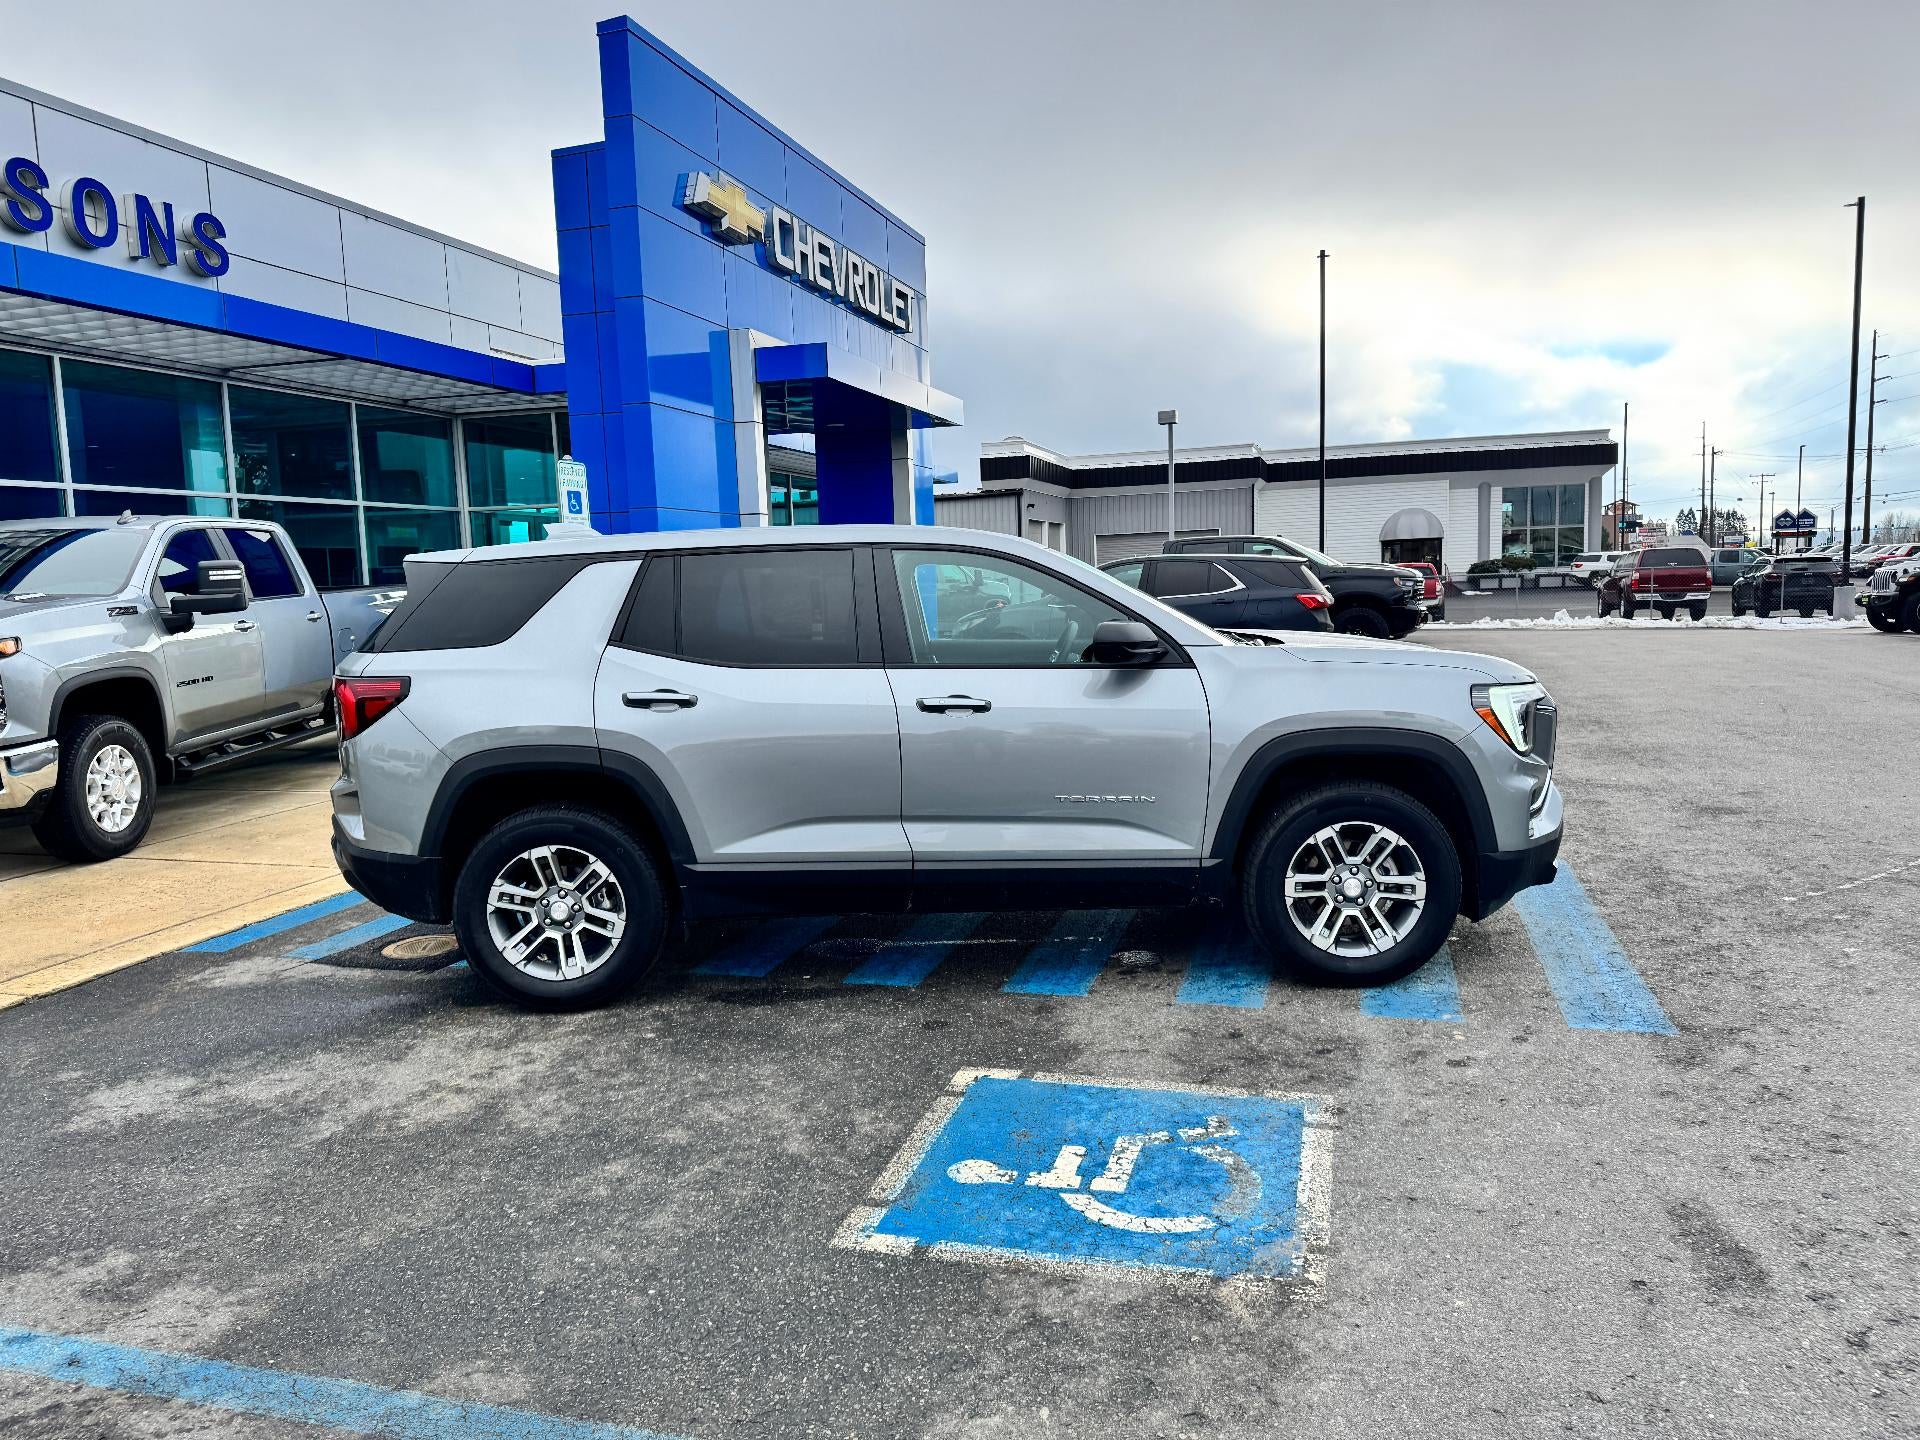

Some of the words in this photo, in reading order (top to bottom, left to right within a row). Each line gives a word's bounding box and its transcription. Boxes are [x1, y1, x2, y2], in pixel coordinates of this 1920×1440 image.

[1, 157, 230, 277] SONS
[768, 205, 915, 334] CHEVROLET
[201, 675, 214, 683] HD
[1054, 794, 1156, 804] TERRAIN
